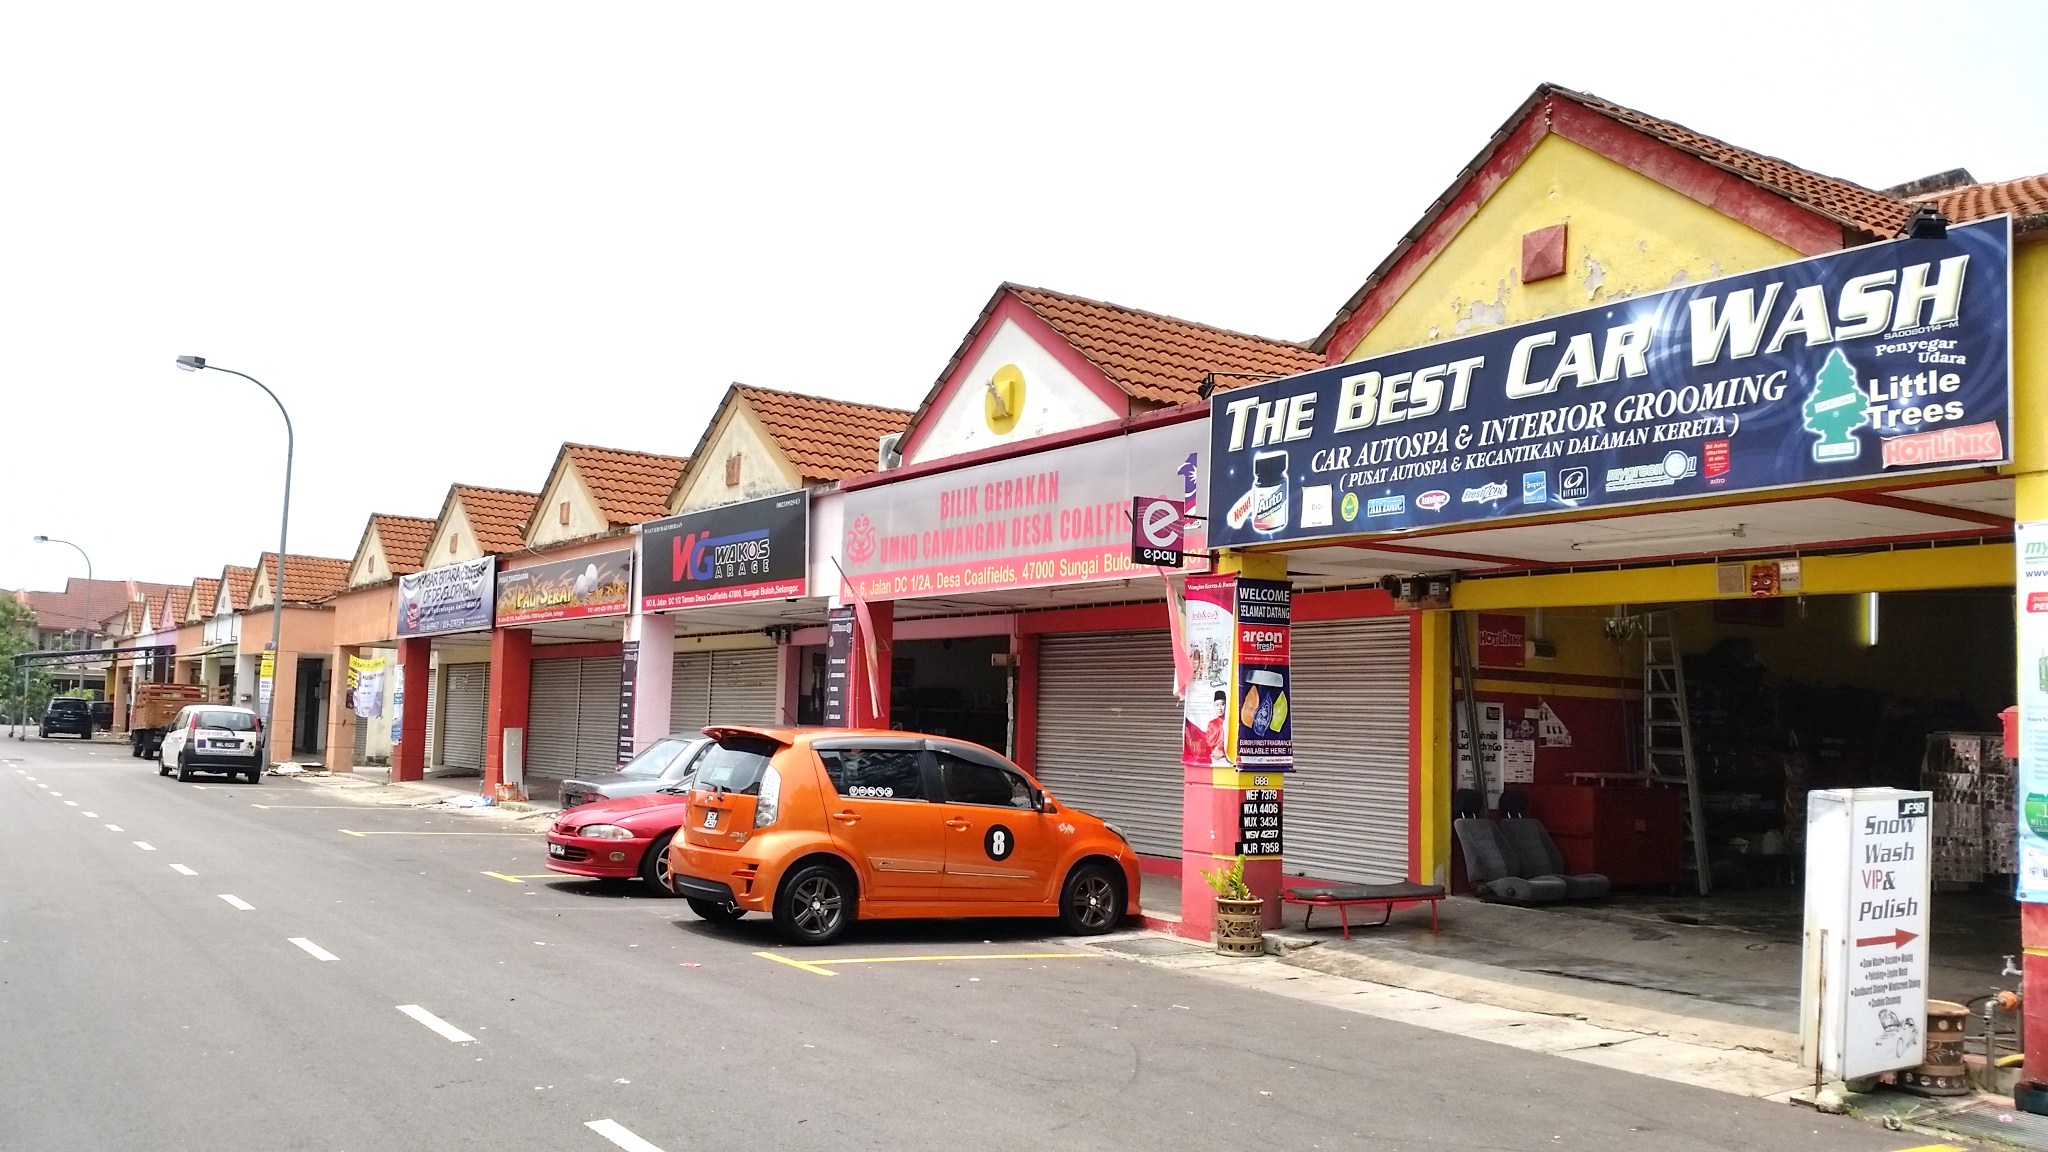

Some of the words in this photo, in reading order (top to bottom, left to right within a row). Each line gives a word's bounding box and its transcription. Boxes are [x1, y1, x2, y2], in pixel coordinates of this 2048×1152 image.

[1226, 392, 1317, 452] THE
[1333, 355, 1485, 433] BEST
[1505, 321, 1654, 400] CAR
[1689, 254, 1970, 366] WASH
[1875, 339, 1957, 357] Penyegar
[1918, 351, 1966, 365] Udara
[1869, 369, 1961, 404] Little
[1312, 447, 1350, 473] CAR
[1354, 427, 1448, 469] AUTOSPA
[1455, 424, 1474, 451] &
[1477, 400, 1606, 448] INTERIOR
[1615, 370, 1788, 425] GROOMING
[1867, 400, 1964, 430] Trees
[1389, 457, 1448, 482] AUTOSPA
[1451, 456, 1463, 473] &
[1465, 440, 1565, 470] KECANTIKAN
[1566, 427, 1651, 456] DALAMAN
[1652, 417, 1726, 443] KERETA
[940, 486, 979, 520] BILIK
[984, 470, 1060, 513] GERAKAN
[1257, 491, 1283, 512] Auto
[1233, 496, 1251, 522] New!
[880, 531, 919, 564] UMNO
[923, 521, 1008, 561] CAWANGAN
[1011, 512, 1053, 547] DESA
[1060, 501, 1131, 541] COALFIE
[715, 538, 770, 566] WAKOS
[870, 579, 892, 595] Jalan
[894, 576, 908, 592] DC
[911, 574, 934, 593] 1/2A,
[937, 571, 961, 588] Desa
[964, 564, 1017, 587] Coalfields,
[1022, 559, 1055, 580] 47000
[1059, 554, 1099, 580] Sungai
[516, 583, 536, 609] PAU
[695, 593, 706, 602] Desa
[743, 587, 760, 598] Sungai
[1239, 587, 1290, 602] WELCOME
[1240, 604, 1266, 619] SELAMAT
[1266, 606, 1290, 620] DATANG
[1242, 630, 1283, 644] areon
[1239, 747, 1269, 756] AVAILABLE
[1270, 747, 1286, 757] HERE
[1245, 790, 1259, 800] WEF
[1260, 790, 1278, 800] 7379
[1243, 804, 1258, 814] WXA
[1260, 803, 1279, 814] 4406
[1243, 816, 1257, 828] WUX
[1260, 816, 1278, 827] 3434
[1864, 815, 1915, 835] Snow
[993, 831, 1005, 855] 8
[1245, 830, 1260, 839] WSV
[1260, 830, 1279, 838] 4297
[1242, 843, 1258, 855] WJR
[1260, 842, 1279, 853] 7958
[1865, 841, 1915, 864] Wash
[1858, 896, 1918, 922] Polish
